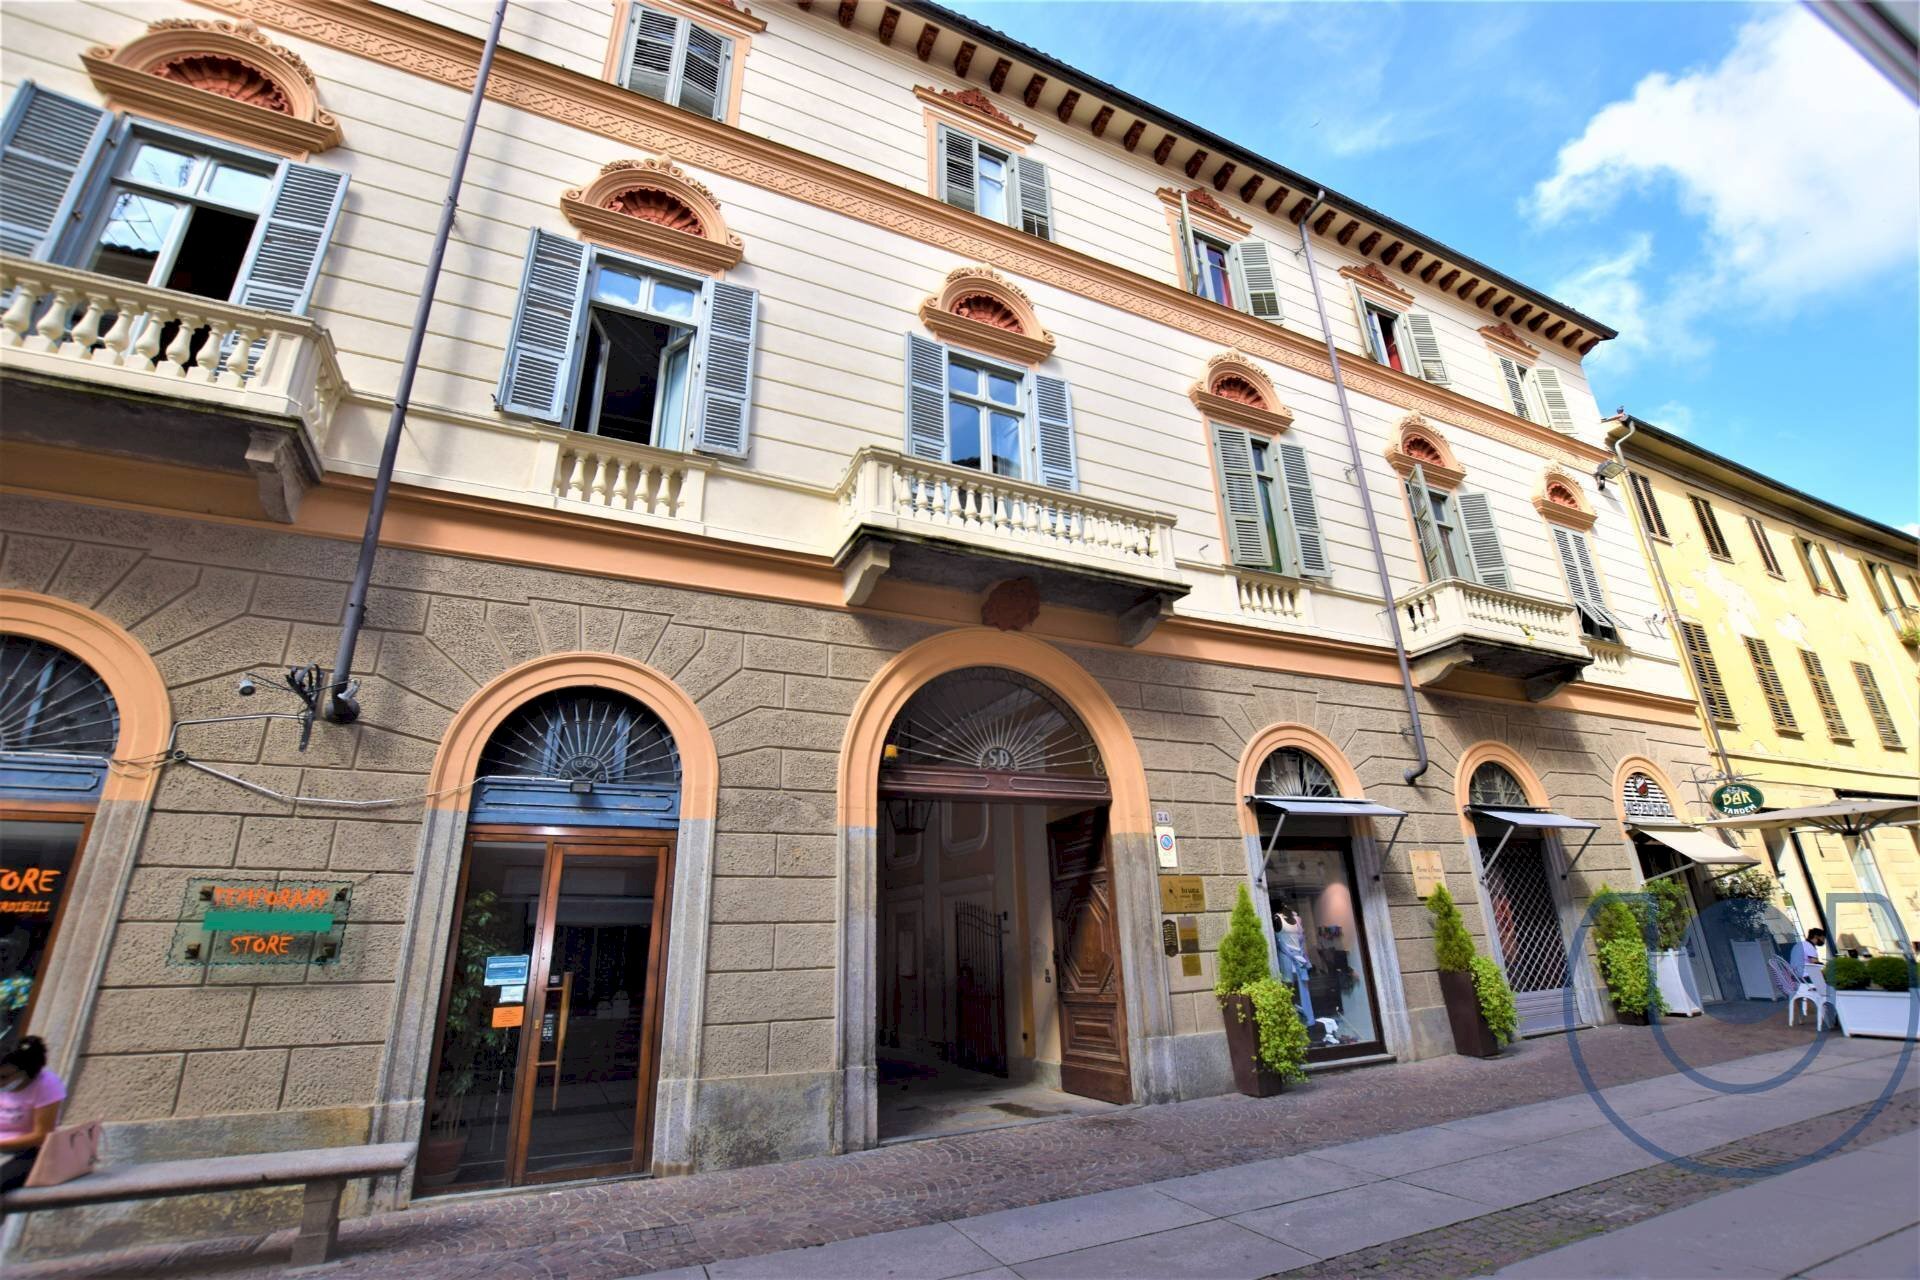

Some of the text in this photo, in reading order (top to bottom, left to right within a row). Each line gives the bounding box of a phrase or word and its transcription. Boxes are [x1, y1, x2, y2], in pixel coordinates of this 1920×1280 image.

[1721, 791, 1753, 805] BAR
[1723, 803, 1757, 815] TANDEM
[213, 886, 330, 909] TEMPORARY
[230, 934, 296, 956] STORE
